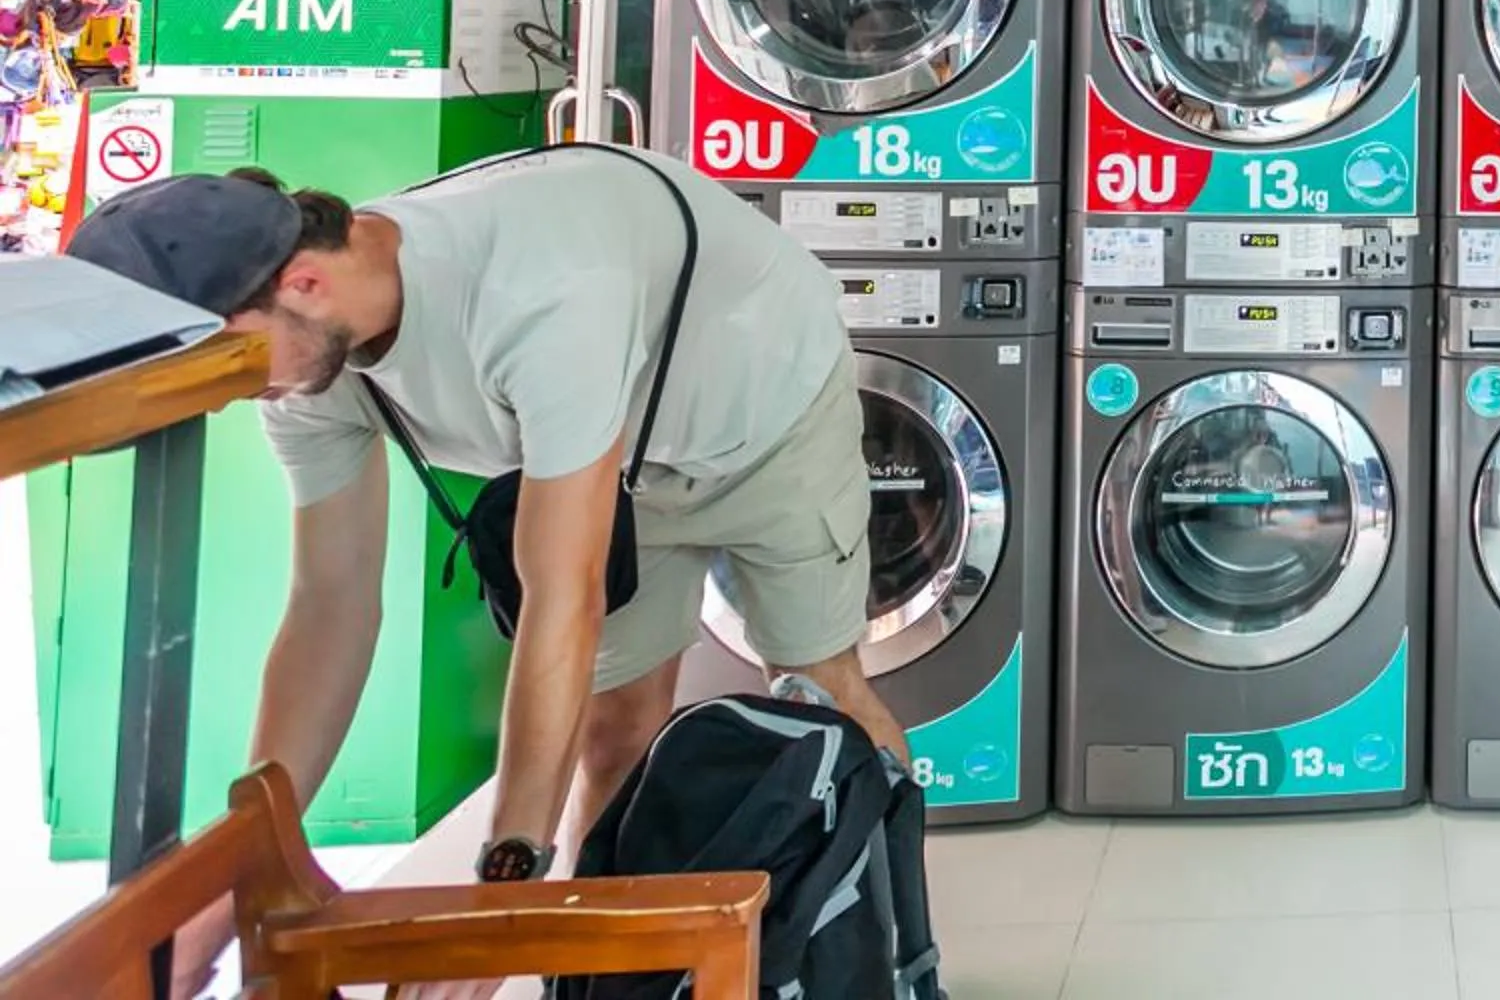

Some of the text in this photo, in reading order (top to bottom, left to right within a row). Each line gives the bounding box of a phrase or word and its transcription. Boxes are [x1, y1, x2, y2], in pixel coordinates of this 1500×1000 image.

[702, 119, 942, 179] อบ 18 kg
[1096, 153, 1329, 211] อบ 13 kg
[1111, 376, 1125, 395] 8
[912, 757, 954, 788] 8 kg
[1291, 746, 1325, 778] 13
